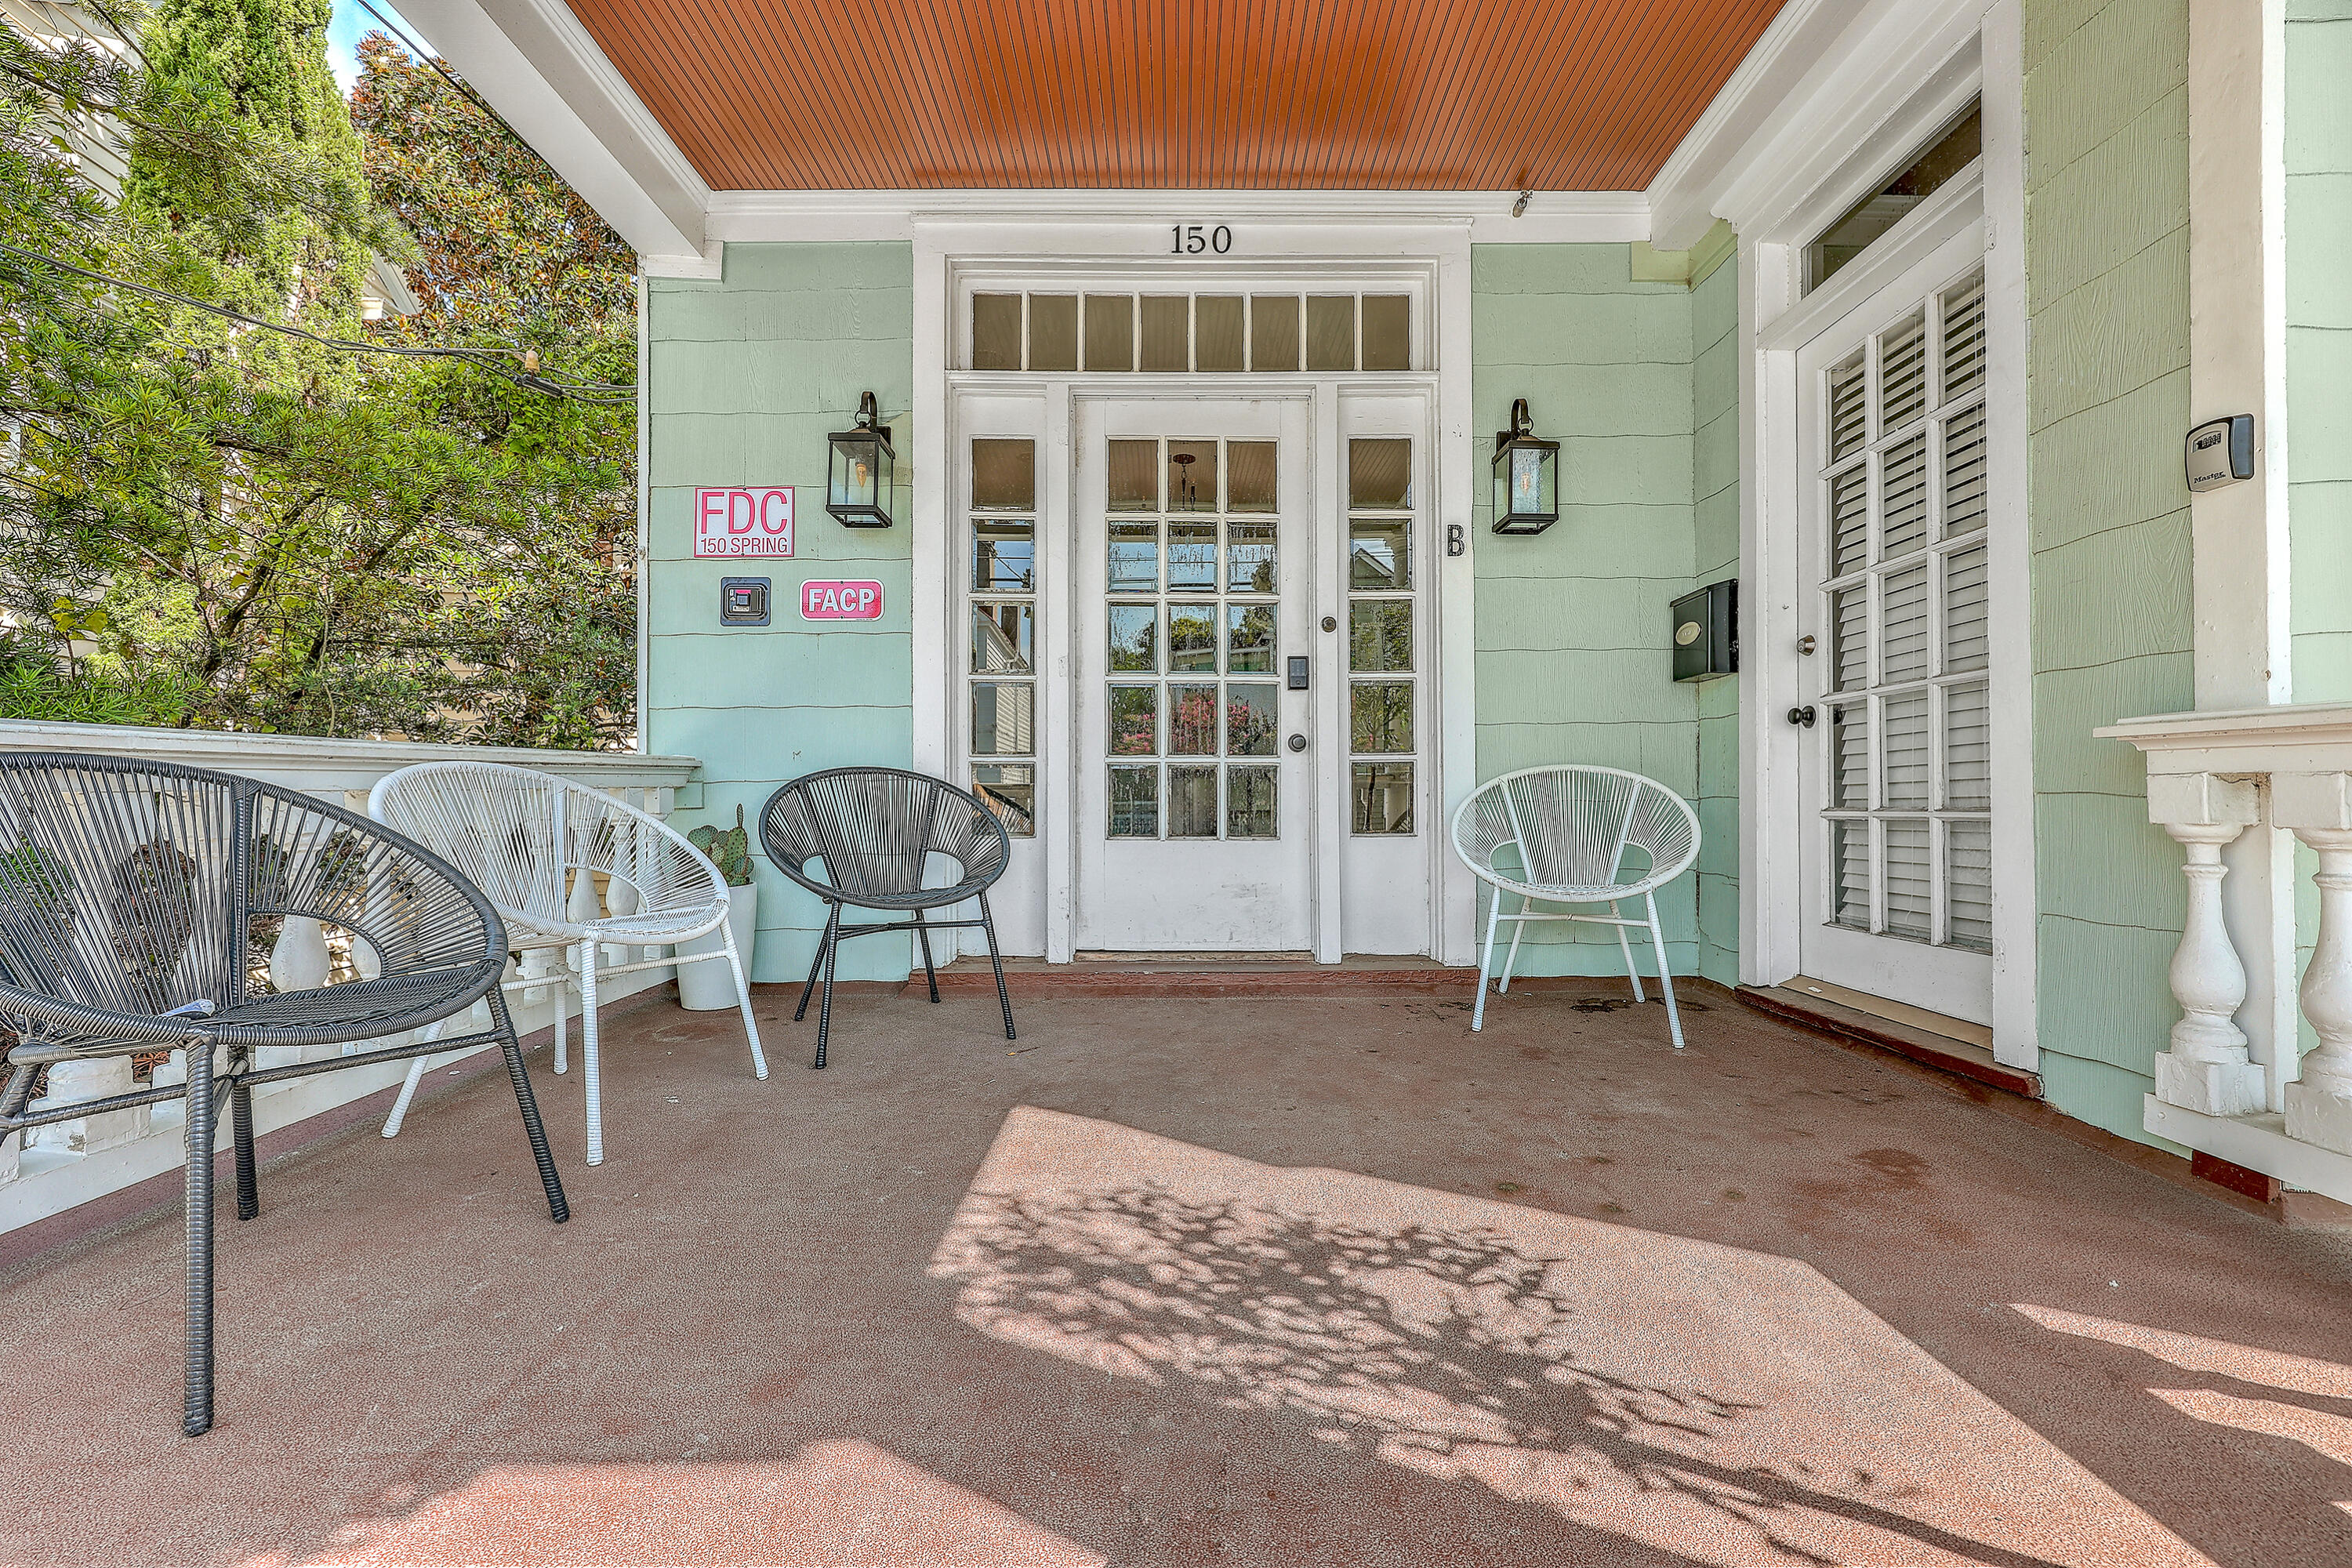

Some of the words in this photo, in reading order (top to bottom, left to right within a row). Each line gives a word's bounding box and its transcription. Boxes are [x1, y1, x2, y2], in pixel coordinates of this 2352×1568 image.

[1171, 225, 1232, 253] 150
[2194, 471, 2223, 484] Master
[702, 491, 787, 534] FDC
[701, 537, 726, 553] 150
[731, 537, 787, 553] SPRING
[1447, 524, 1465, 557] B
[808, 588, 875, 612] FACP
